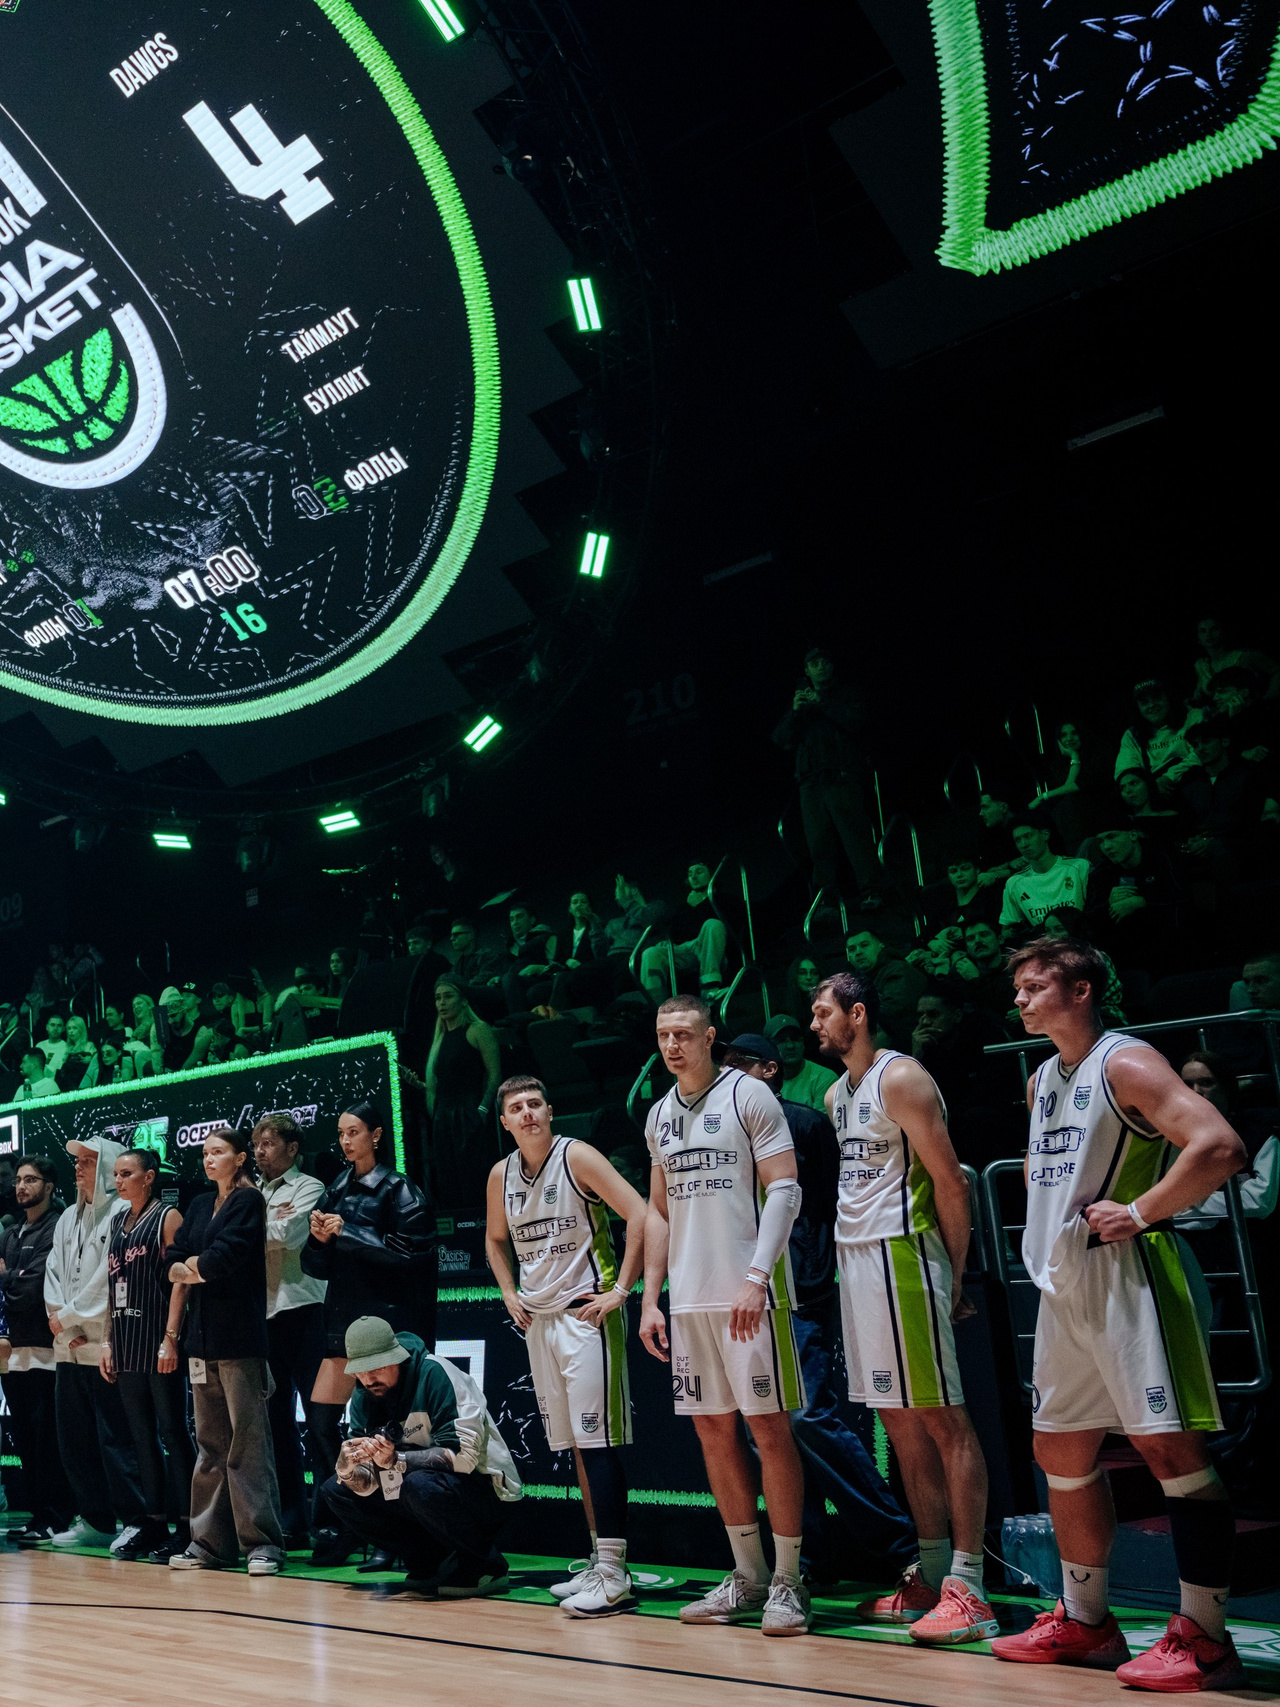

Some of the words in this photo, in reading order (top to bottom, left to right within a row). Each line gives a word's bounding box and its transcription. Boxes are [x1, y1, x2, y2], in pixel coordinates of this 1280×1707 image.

[109, 32, 179, 98] DAWGS
[182, 100, 335, 226] 4
[280, 306, 360, 364] ТАЙМАУТ
[303, 365, 371, 415] БУЛЛИТ
[343, 446, 409, 492] ФОЛЫ
[164, 545, 260, 610] 07:00
[23, 615, 70, 648] ФОЛЫ
[220, 602, 267, 641] 16
[624, 673, 696, 726] 210
[1029, 899, 1076, 919] Emirates
[1040, 1091, 1057, 1123] 10
[660, 1115, 683, 1147] 24
[706, 1179, 733, 1190] REC
[857, 1168, 886, 1180] REC
[517, 1252, 534, 1263] OUT
[550, 1242, 577, 1255] REC
[672, 1375, 702, 1402] 24
